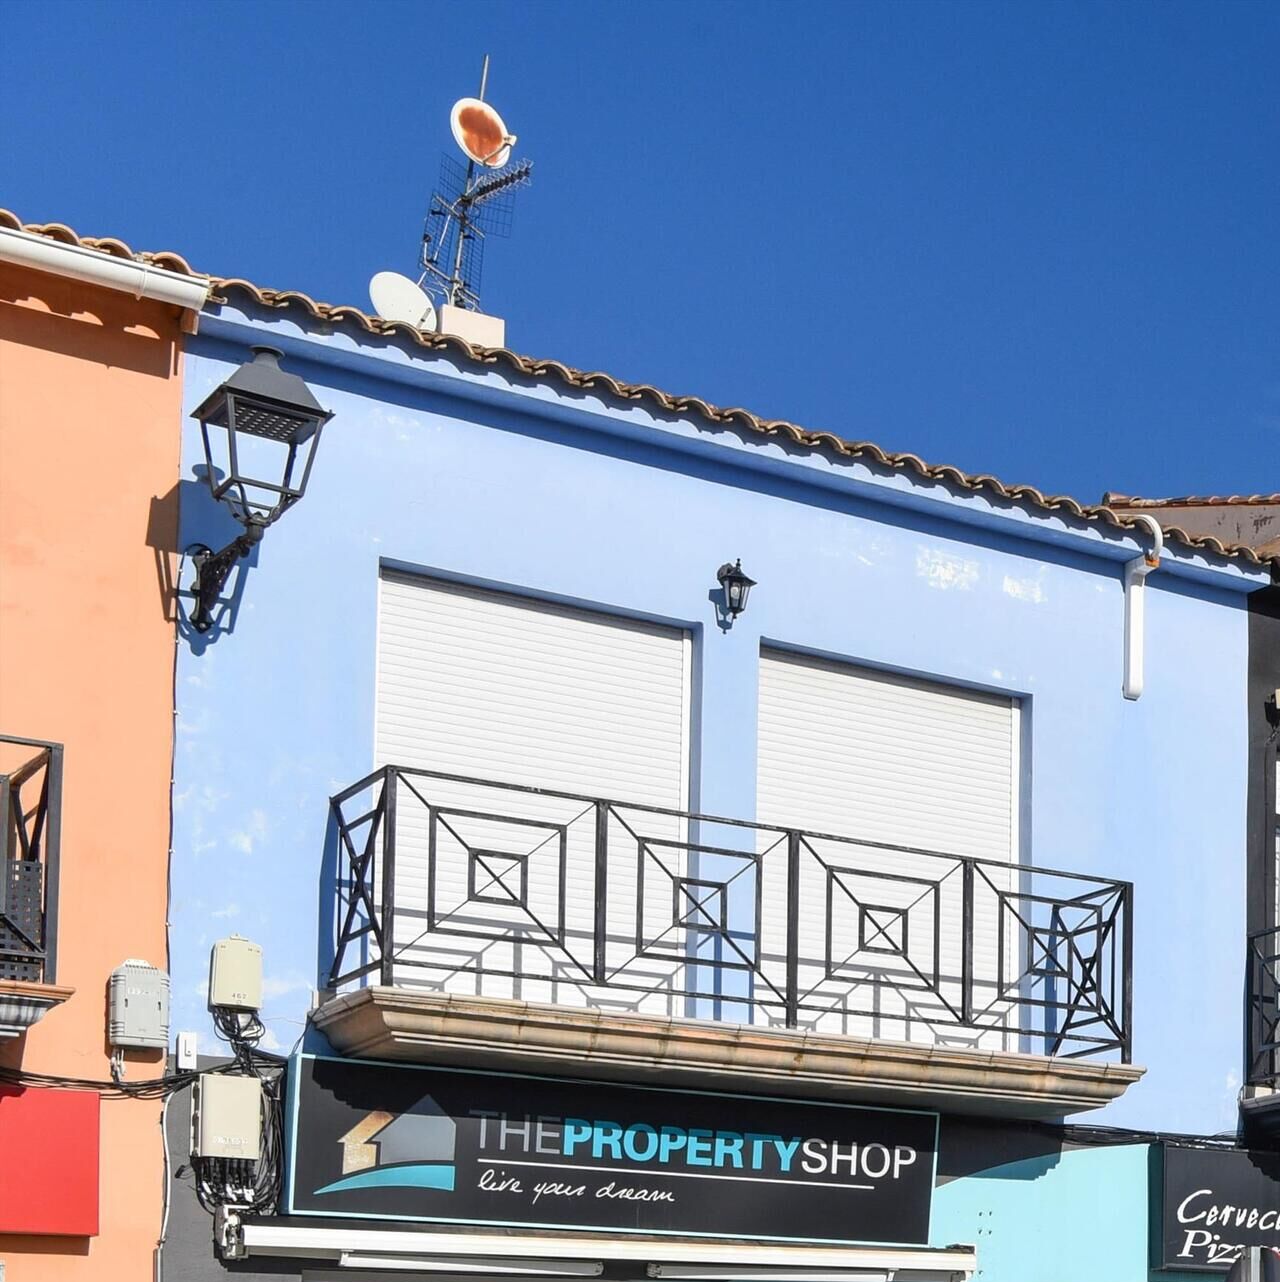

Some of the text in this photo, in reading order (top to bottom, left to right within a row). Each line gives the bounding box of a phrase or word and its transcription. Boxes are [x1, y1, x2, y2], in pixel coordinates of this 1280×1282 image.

[477, 1169, 676, 1205] live your dream
